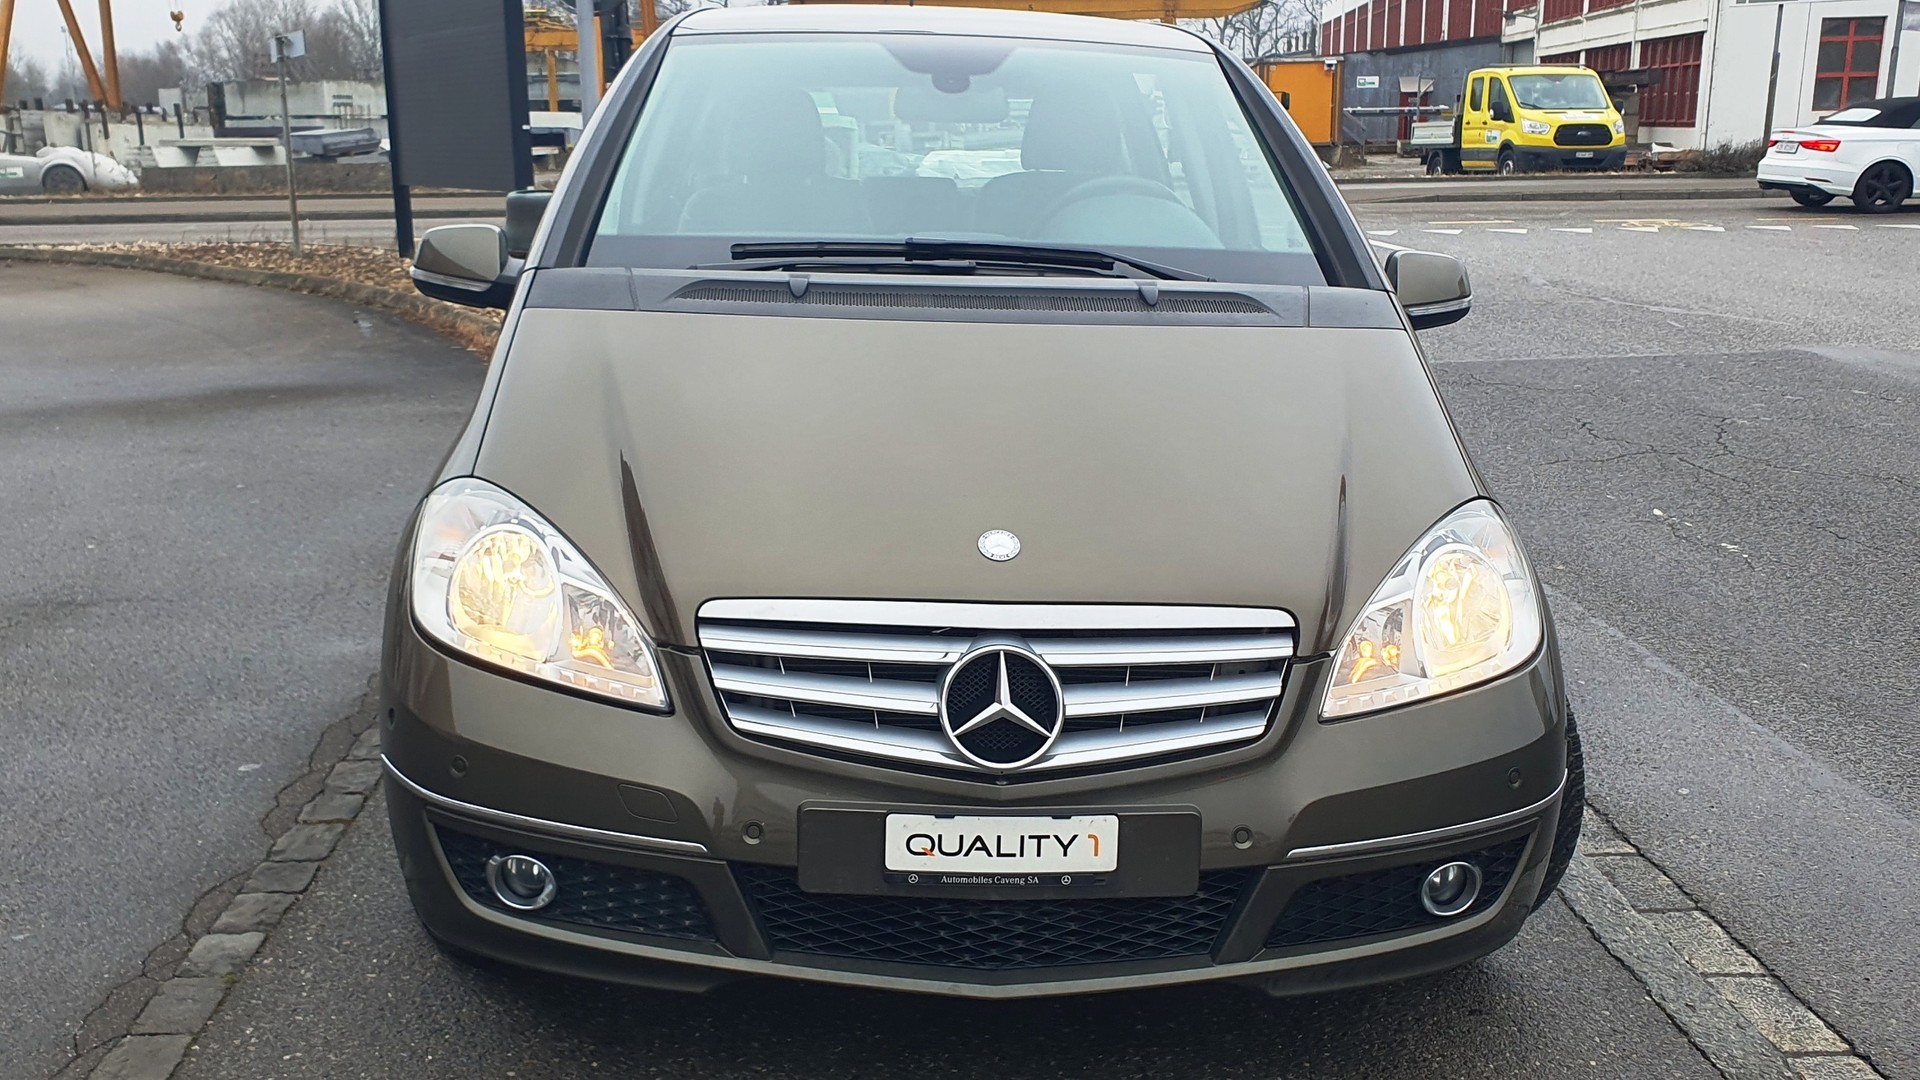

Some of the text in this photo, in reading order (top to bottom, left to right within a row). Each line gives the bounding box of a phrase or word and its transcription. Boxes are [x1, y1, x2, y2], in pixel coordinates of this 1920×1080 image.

[905, 833, 1100, 857] QUALITY 1
[940, 875, 1040, 886] Automobiles Caveng SA
